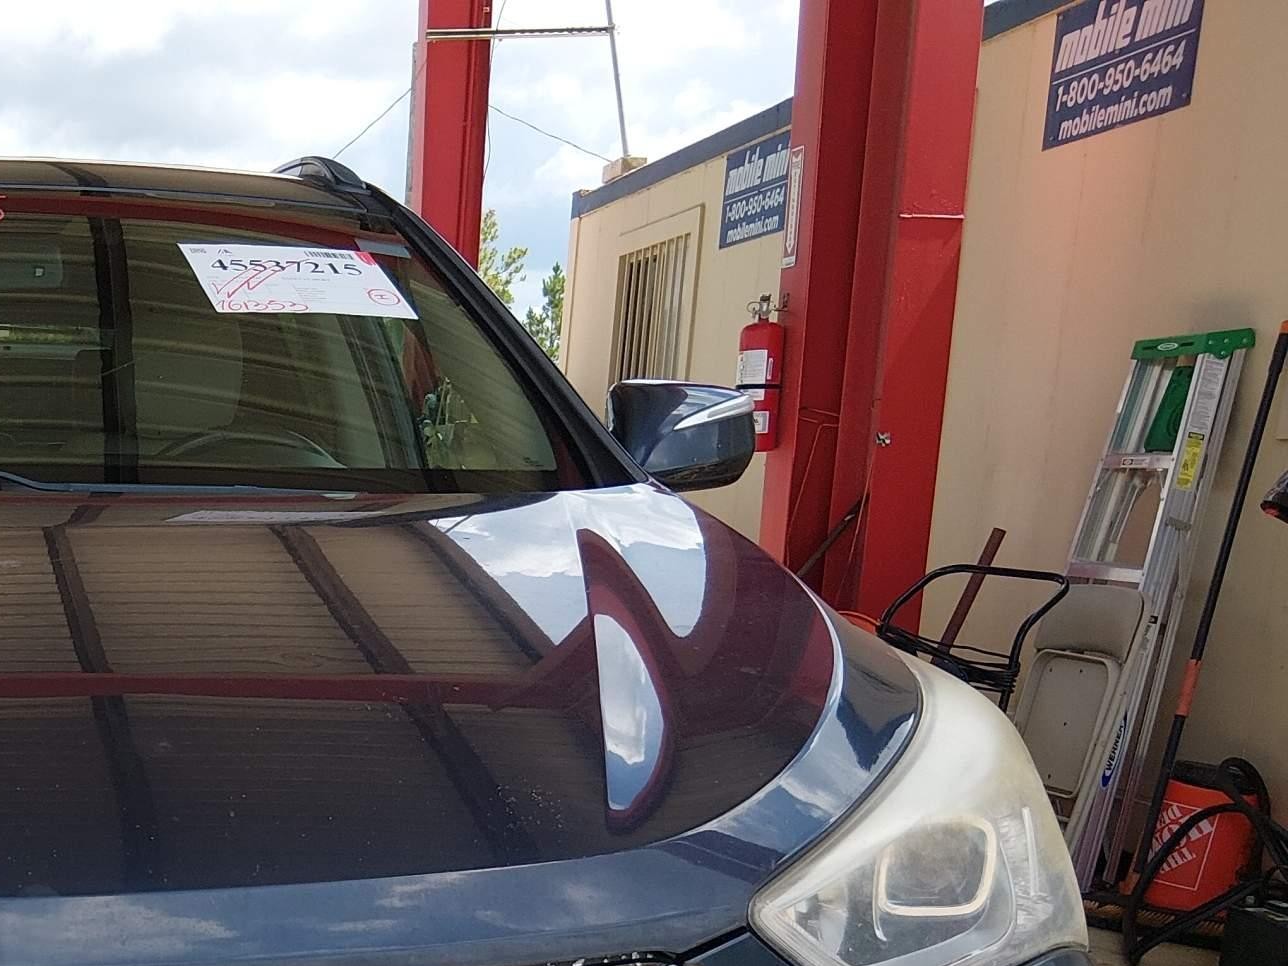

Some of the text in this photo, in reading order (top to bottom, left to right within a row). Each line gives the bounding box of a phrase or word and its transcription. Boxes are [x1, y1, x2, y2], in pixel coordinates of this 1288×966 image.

[1055, 0, 1137, 73] mobile
[1055, 39, 1187, 112] 1-800-950-6464
[1058, 84, 1173, 141] mobilemini.com
[725, 145, 764, 196] mobile
[725, 185, 786, 224] 1-800-950-6464
[726, 215, 779, 244] mobilemini.com
[211, 258, 363, 277] 45537215
